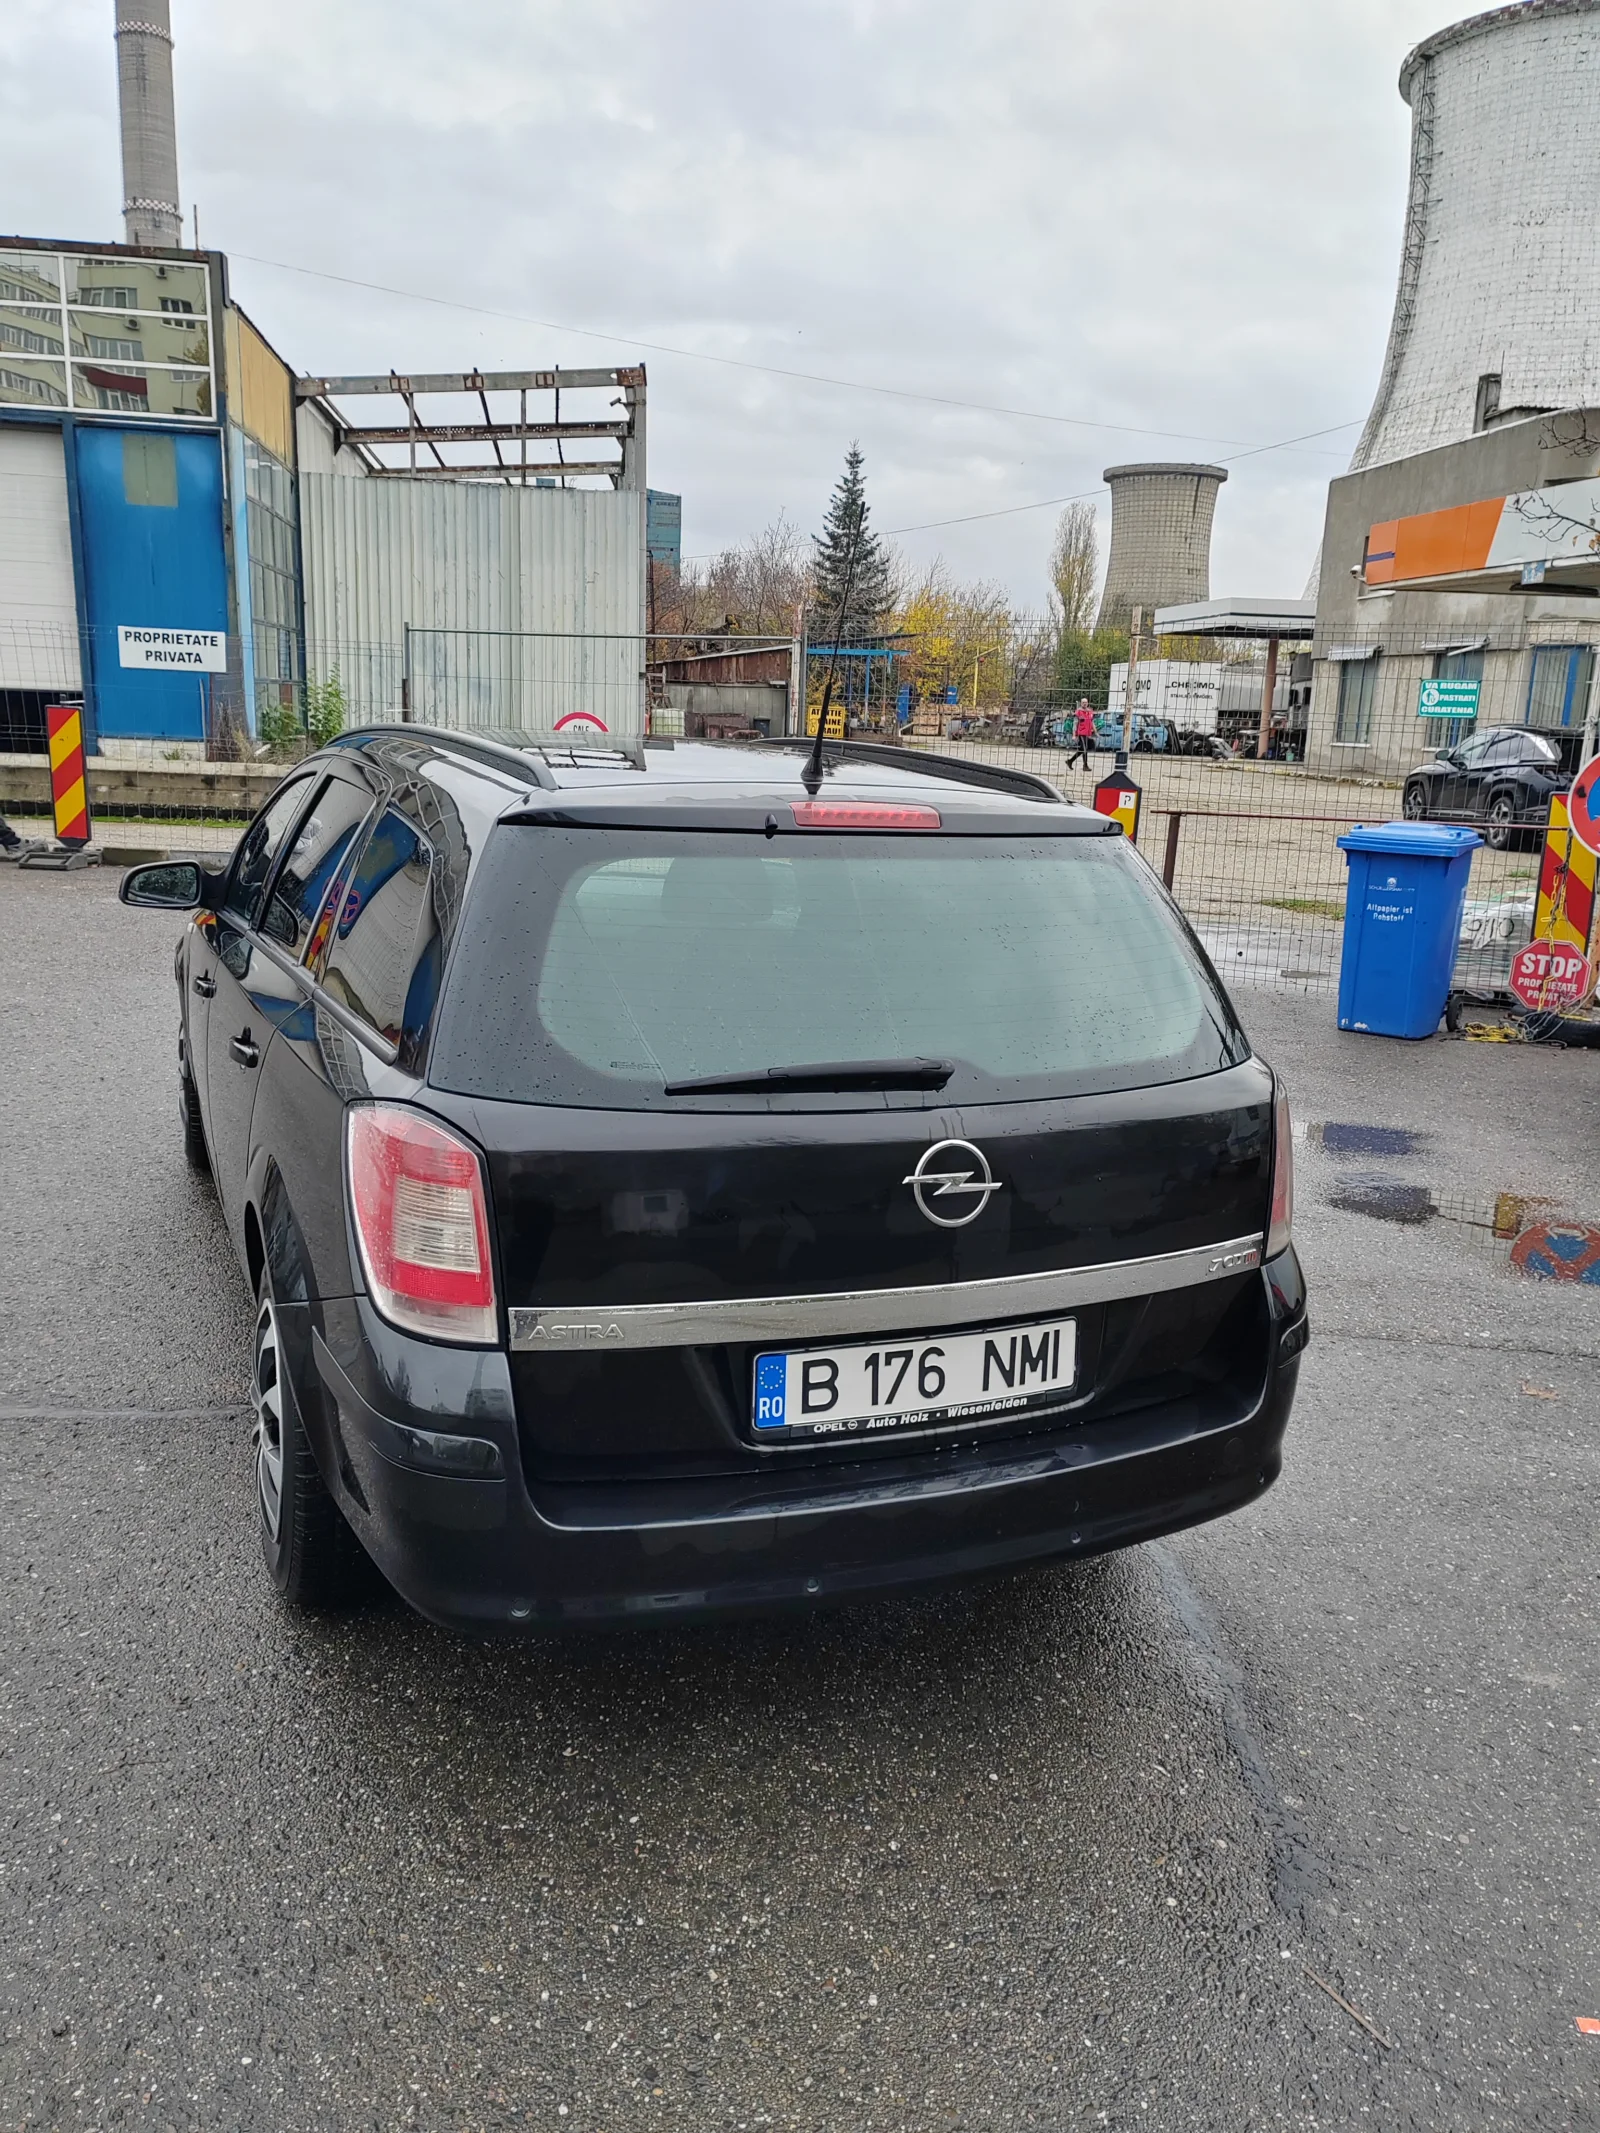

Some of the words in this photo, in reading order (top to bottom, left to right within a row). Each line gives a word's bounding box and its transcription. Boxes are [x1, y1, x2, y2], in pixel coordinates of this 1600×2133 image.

[124, 630, 218, 647] PROPRIETATE
[145, 650, 203, 664] PRIVATA
[1121, 680, 1152, 691] COMO
[1425, 682, 1439, 690] VA
[1440, 694, 1476, 702] PASTRATI
[811, 708, 842, 717] ATTIE
[1421, 705, 1474, 714] CURATENIA
[1366, 902, 1400, 913] Altpapier
[1402, 905, 1413, 914] ist
[1373, 912, 1405, 922] Rohstoff
[1521, 952, 1583, 979] STOP
[1517, 977, 1578, 992] PROPIETATE
[528, 1323, 624, 1340] ASTRA
[801, 1359, 839, 1415] B
[864, 1346, 946, 1407] 176
[982, 1329, 1061, 1392] NMI
[759, 1397, 783, 1419] RO
[814, 1422, 846, 1433] OPEL
[866, 1414, 897, 1429] Auto
[901, 1411, 929, 1425] Holz
[947, 1396, 1028, 1418] Wiesenfelden
